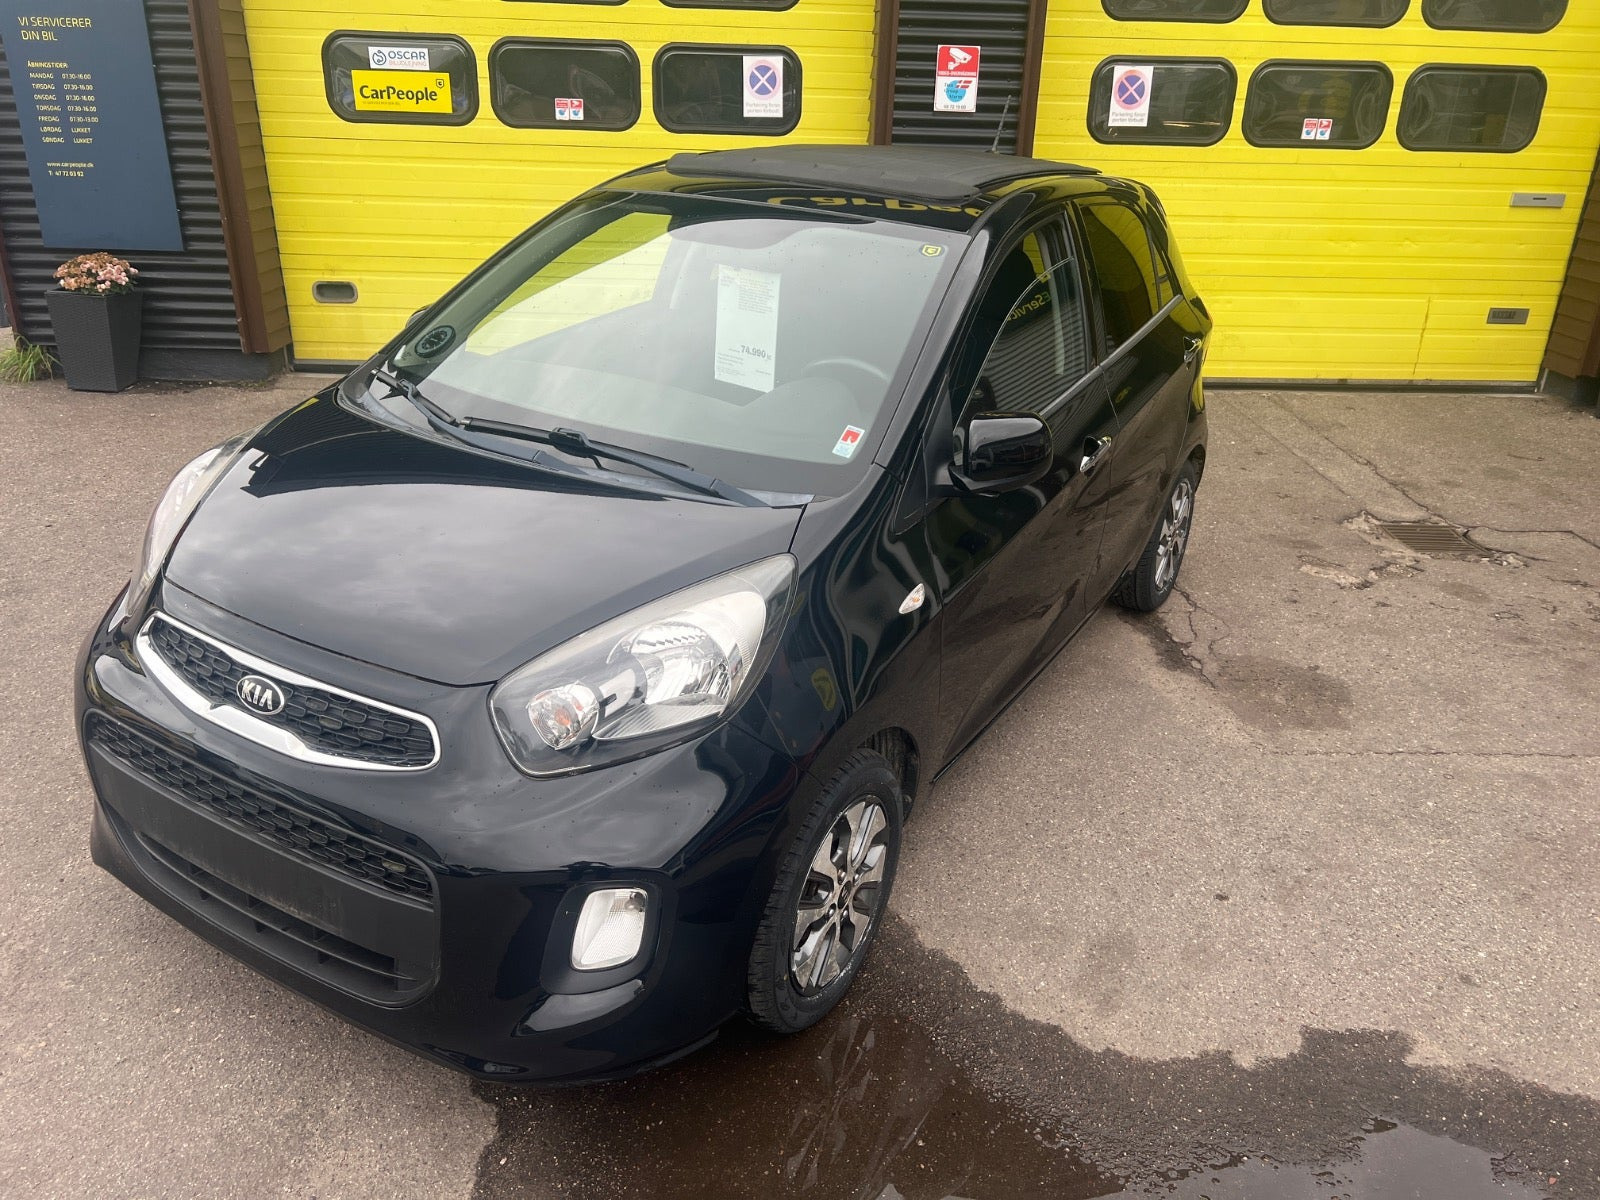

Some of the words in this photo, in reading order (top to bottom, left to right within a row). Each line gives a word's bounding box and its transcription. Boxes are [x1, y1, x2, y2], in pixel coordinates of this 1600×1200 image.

[18, 17, 29, 26] VI
[30, 17, 92, 28] SERVICERER
[21, 30, 39, 40] DIN
[42, 31, 58, 41] BIL
[388, 50, 426, 60] OSCAR
[359, 85, 438, 104] CarPeople
[241, 679, 273, 711] KIA
